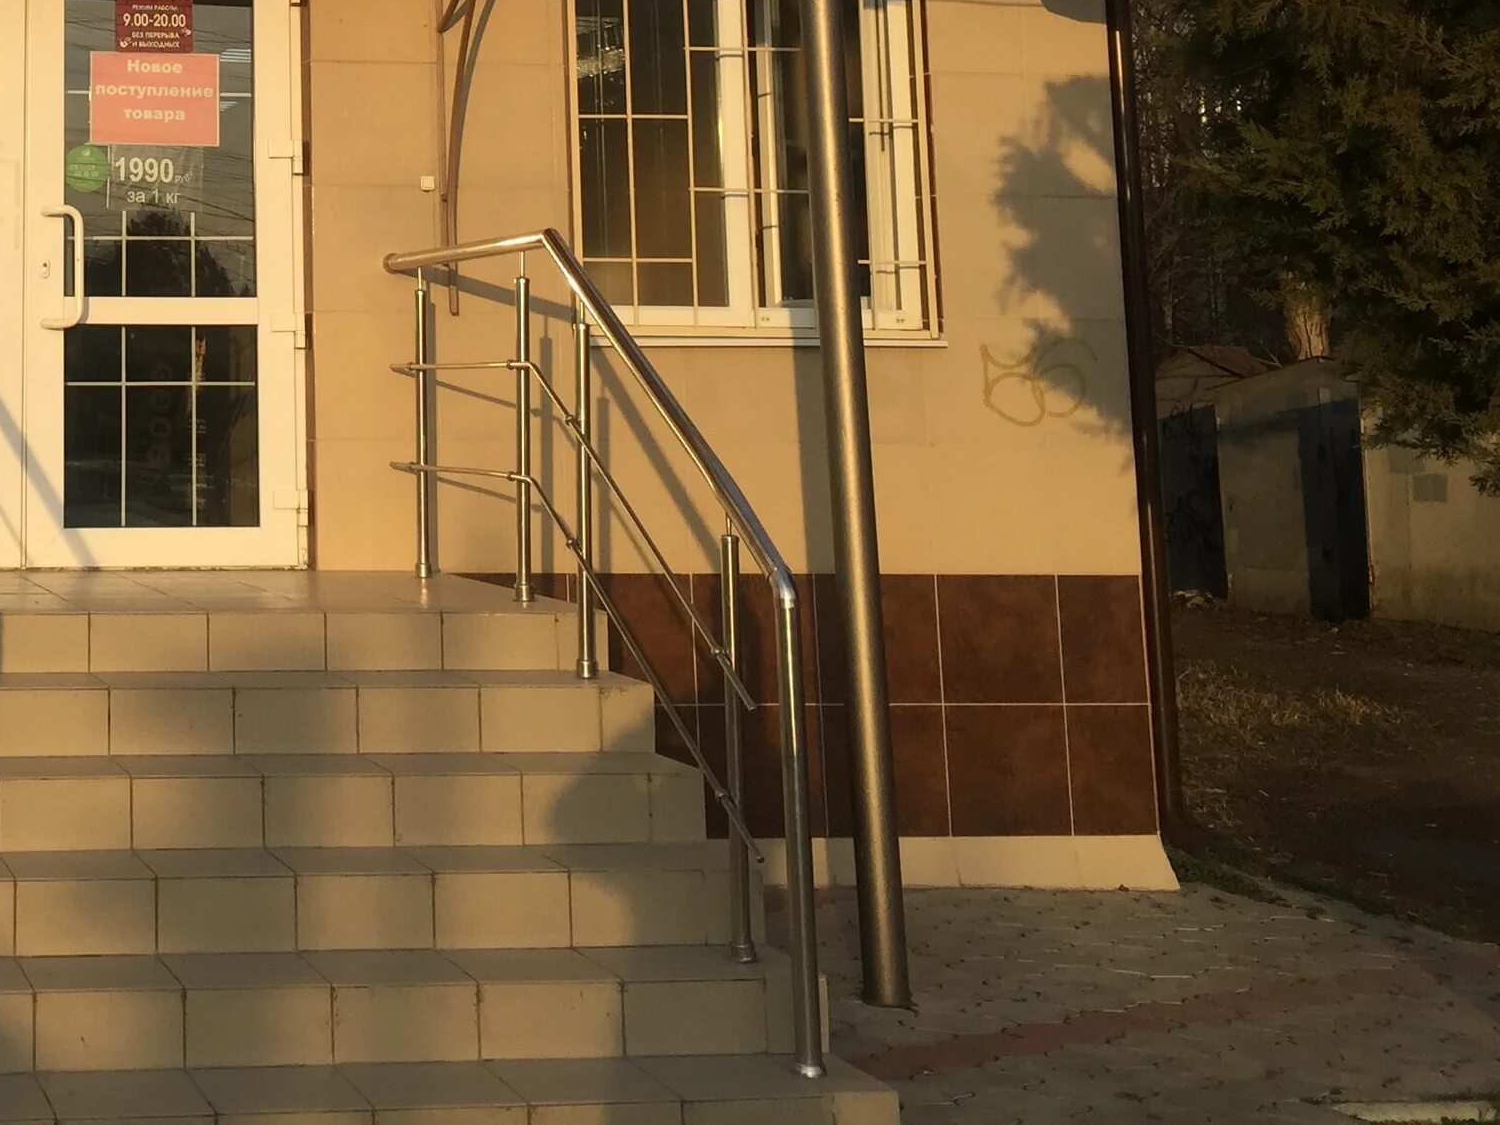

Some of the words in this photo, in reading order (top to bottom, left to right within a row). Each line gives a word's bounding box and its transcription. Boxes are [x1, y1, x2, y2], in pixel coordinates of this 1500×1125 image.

[122, 12, 187, 28] 9.00-20.00
[127, 59, 184, 75] Новое
[95, 83, 214, 99] поступление
[123, 108, 186, 123] товара
[115, 157, 174, 183] 1990
[127, 190, 146, 203] за
[151, 188, 159, 203] 1
[165, 192, 181, 204] кг
